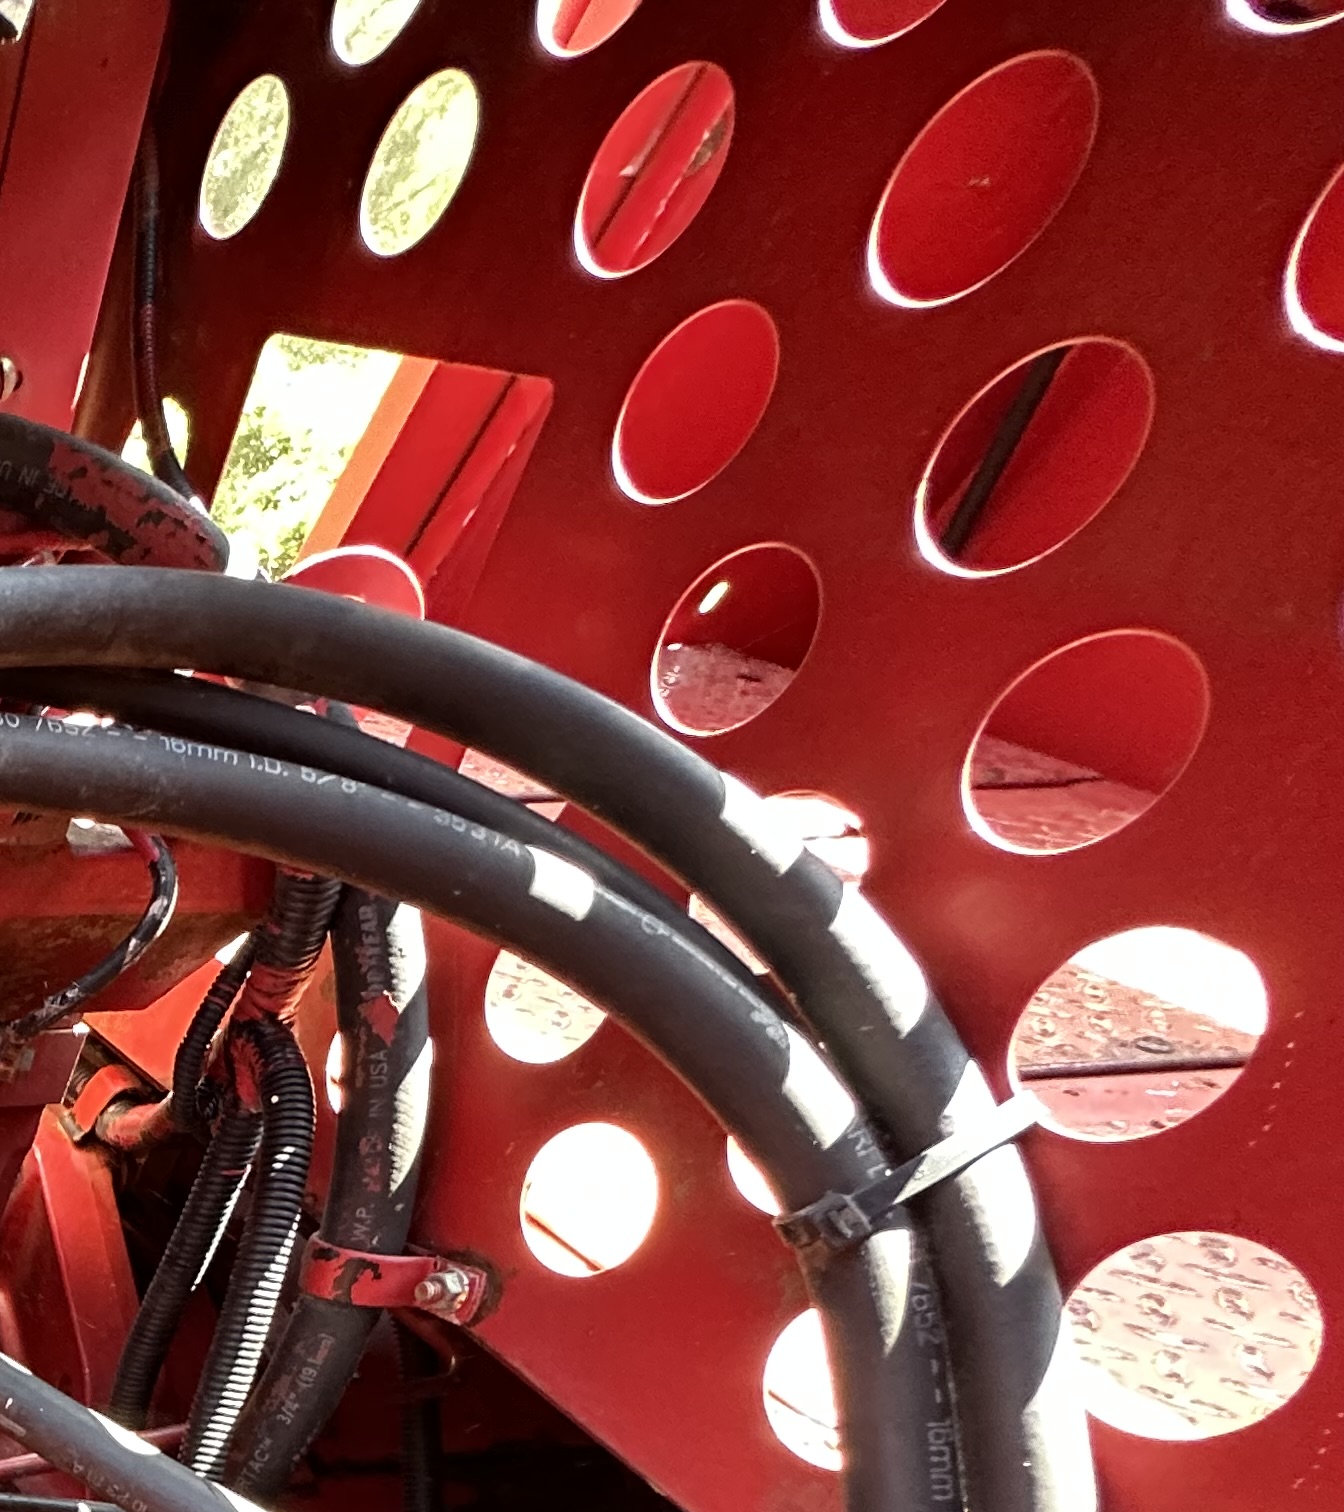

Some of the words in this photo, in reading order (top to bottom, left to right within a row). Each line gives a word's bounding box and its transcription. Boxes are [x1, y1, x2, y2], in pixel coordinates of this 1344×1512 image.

[16, 464, 40, 486] IN
[369, 1049, 388, 1087] USA
[368, 1099, 384, 1118] IN
[919, 1417, 957, 1502] 16mm
